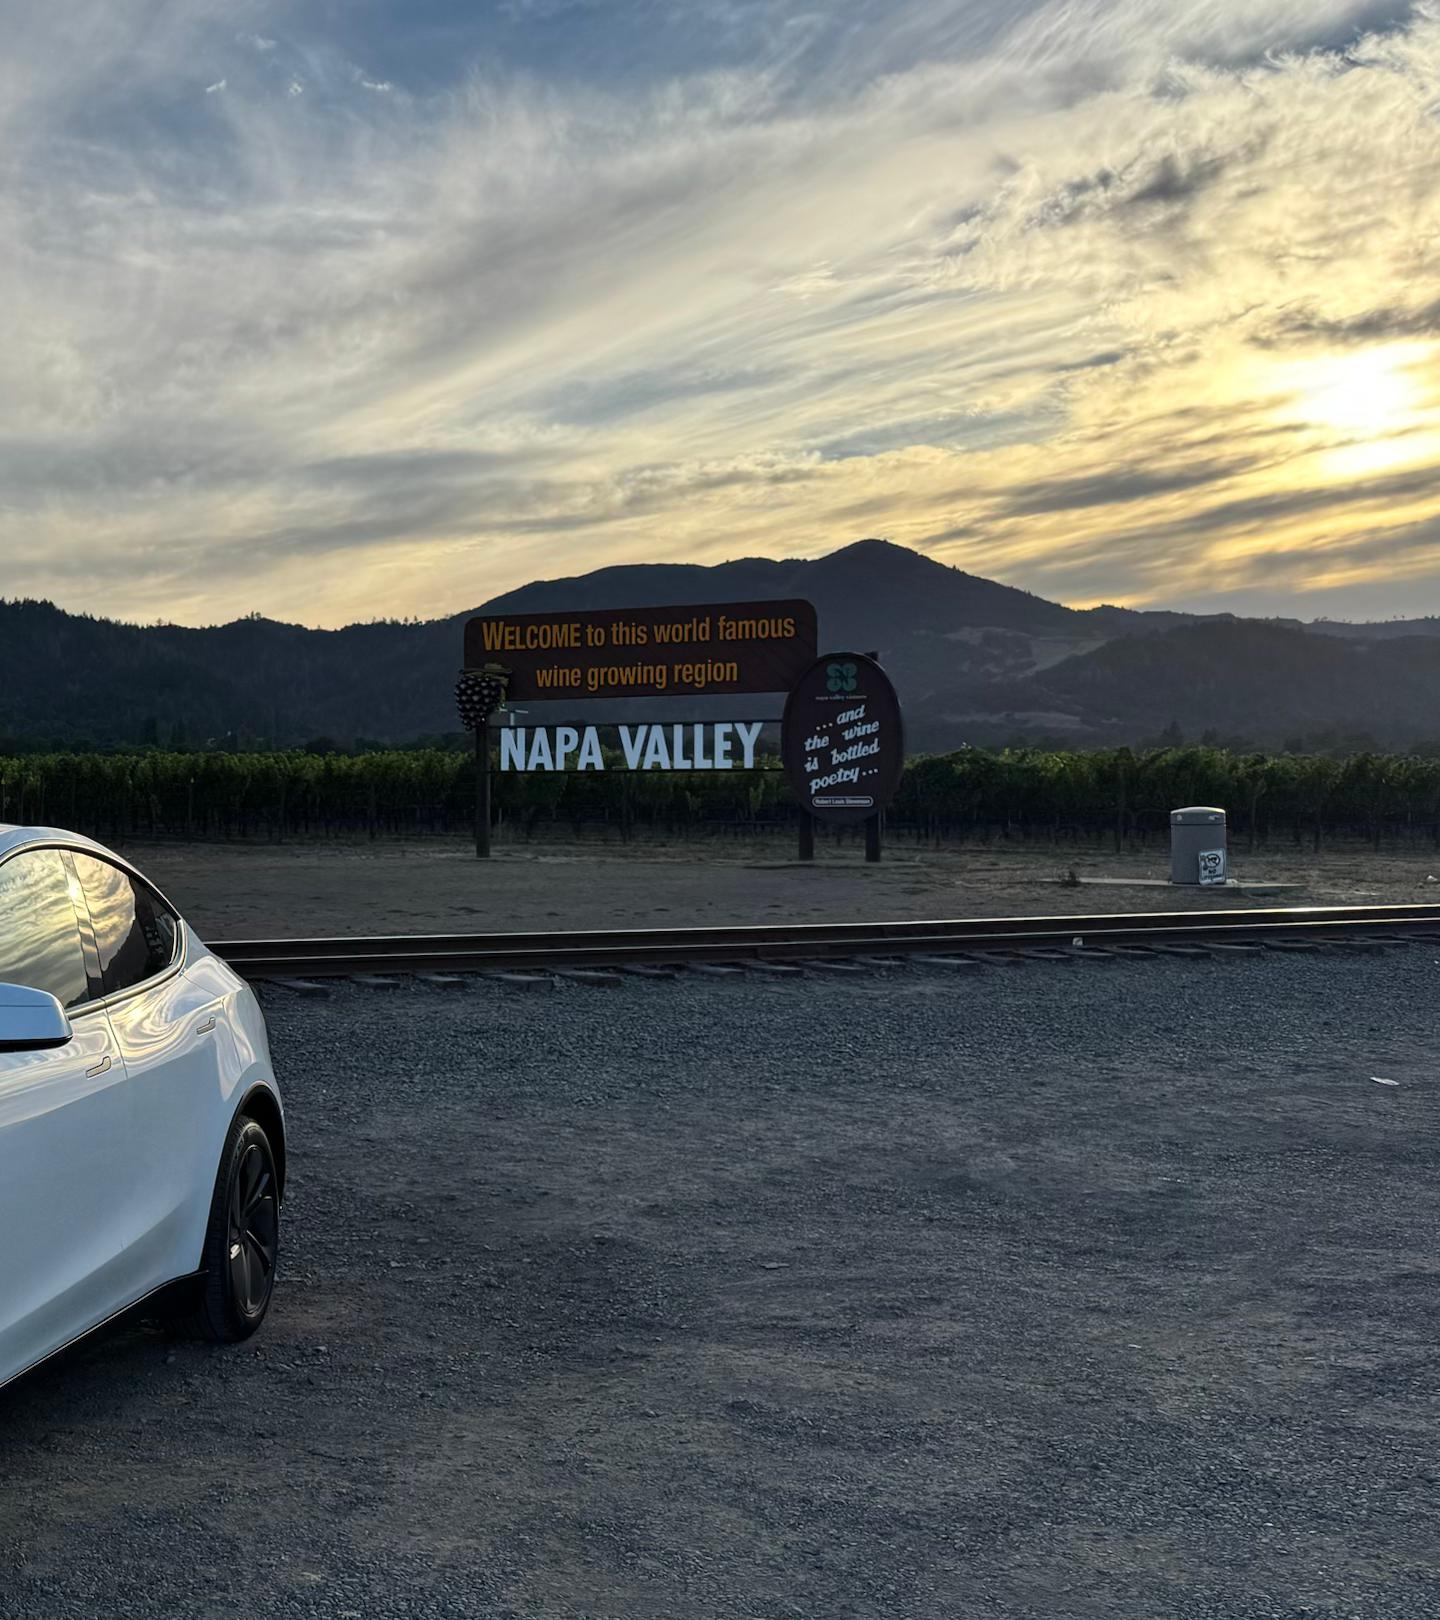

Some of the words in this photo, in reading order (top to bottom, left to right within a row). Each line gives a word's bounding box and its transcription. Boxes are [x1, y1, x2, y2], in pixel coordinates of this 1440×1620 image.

[482, 621, 581, 651] WELCOME
[586, 624, 606, 647] to
[611, 621, 648, 645] this
[654, 617, 710, 643] world
[718, 615, 796, 641] famous
[536, 664, 582, 688] wine
[587, 661, 668, 692] growing
[674, 659, 738, 688] region
[500, 726, 605, 771] NAPA
[618, 722, 764, 770] VALLEY
[804, 735, 830, 752] the
[841, 720, 880, 741] wine
[804, 757, 819, 773] is
[831, 737, 880, 766] bottled
